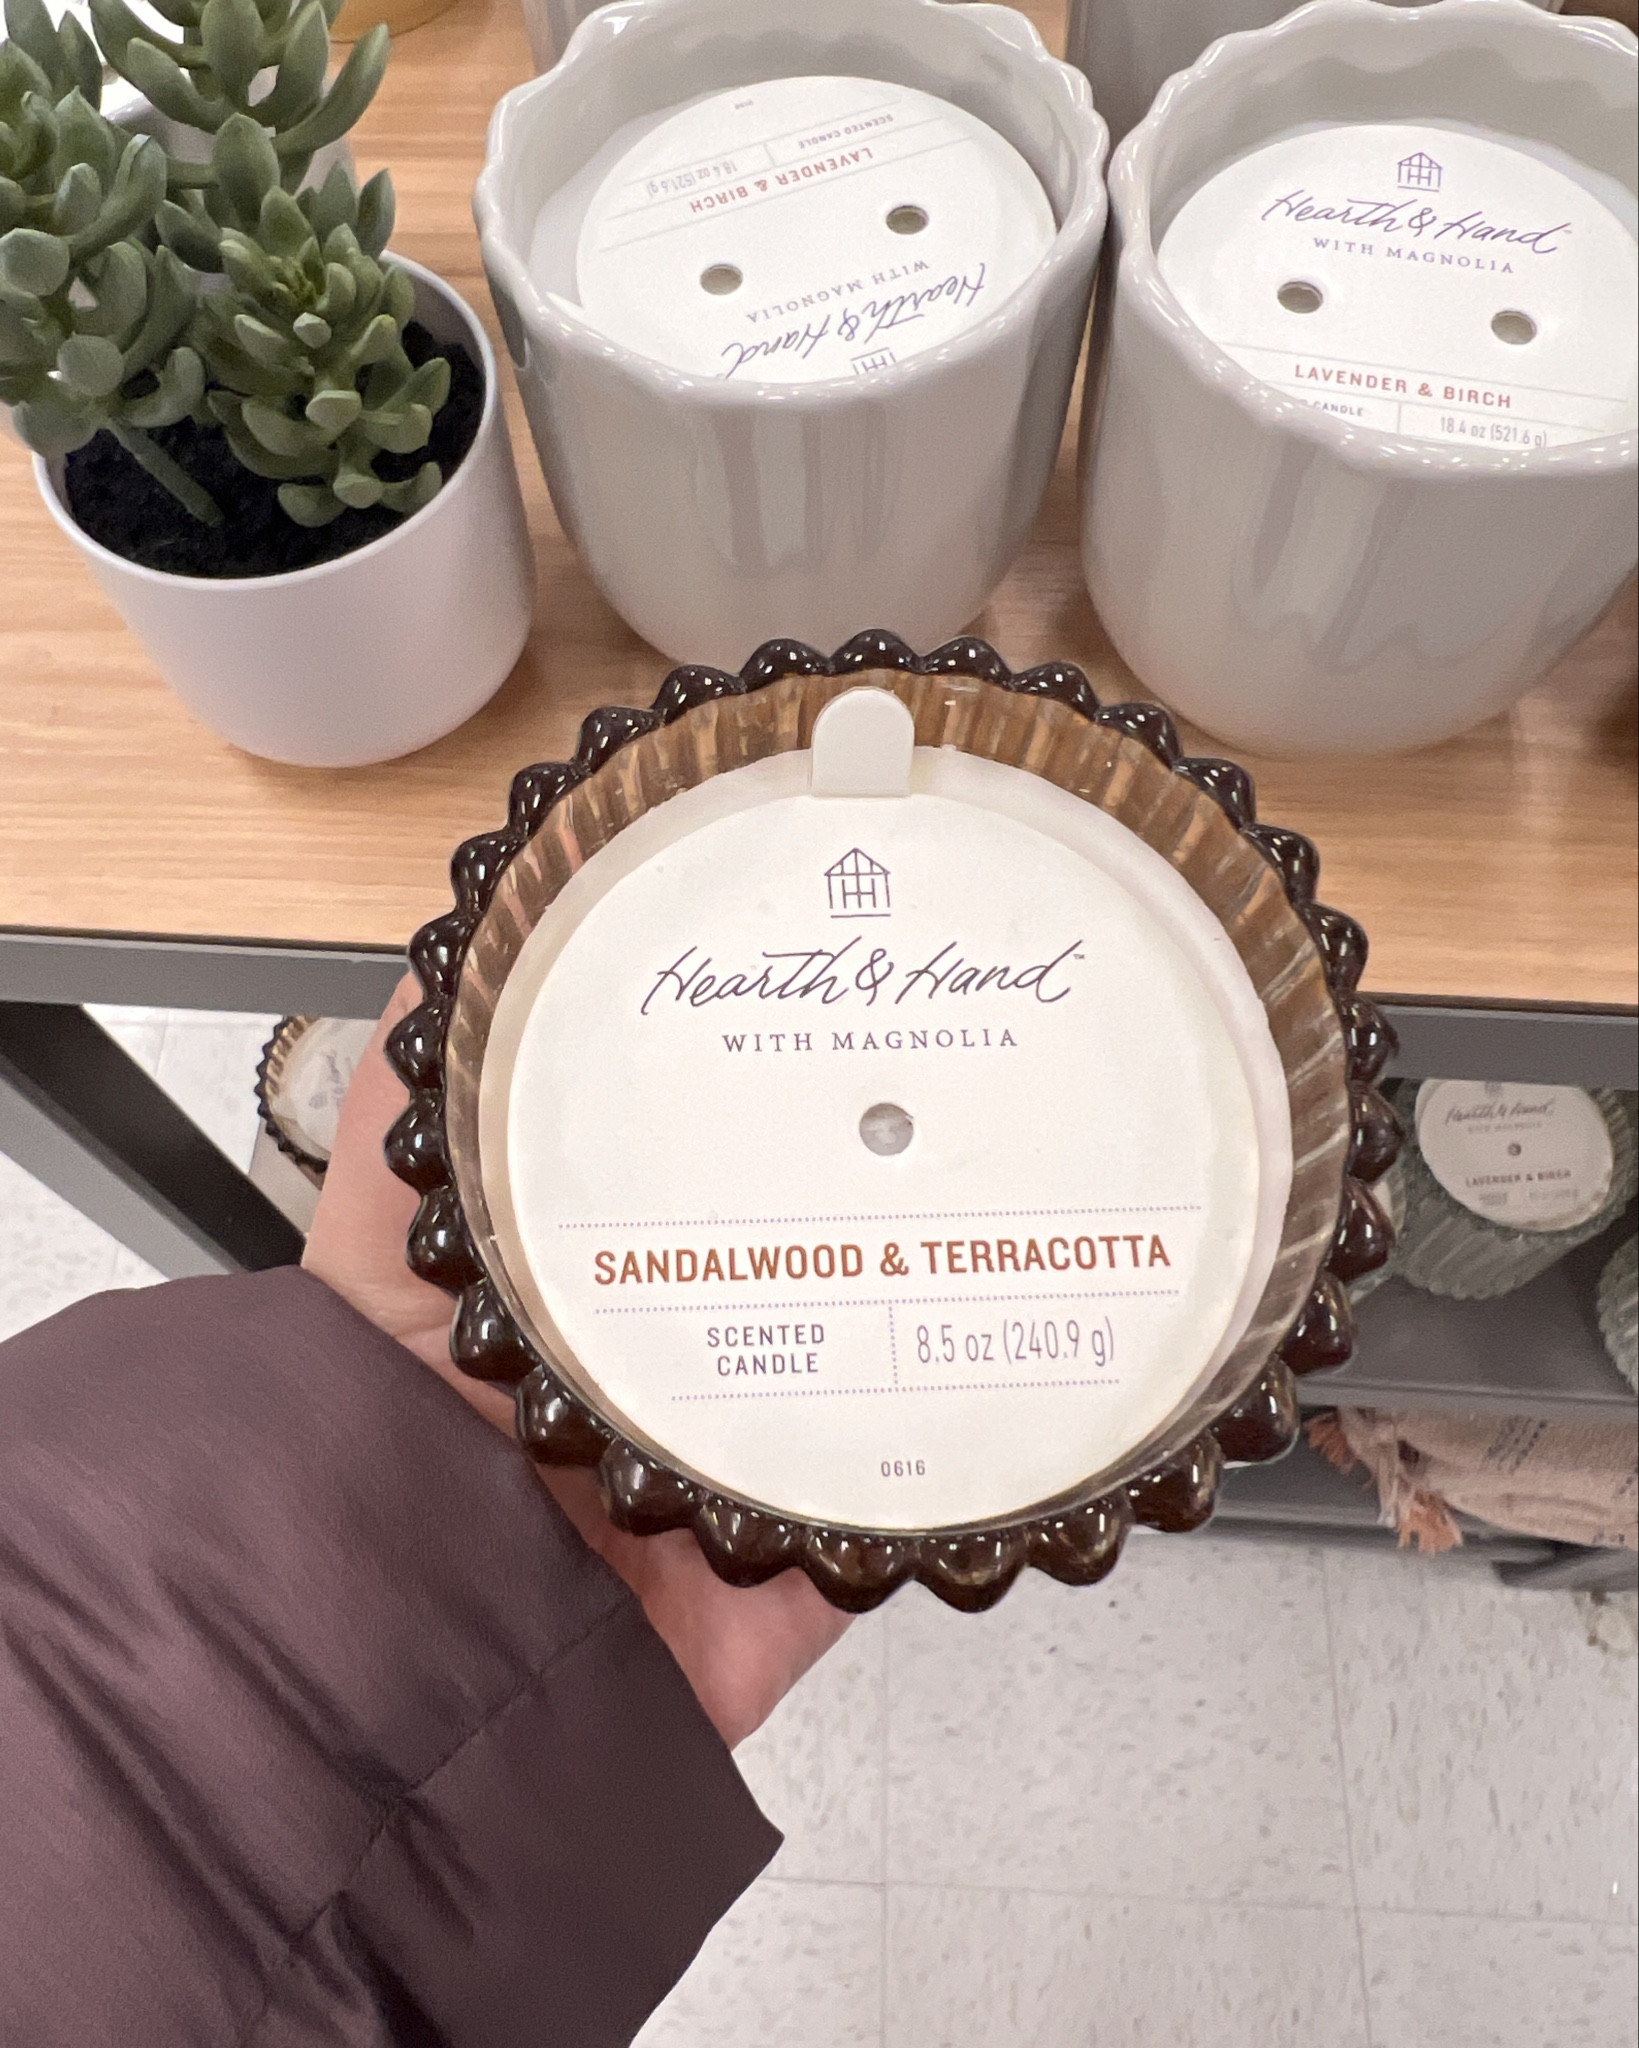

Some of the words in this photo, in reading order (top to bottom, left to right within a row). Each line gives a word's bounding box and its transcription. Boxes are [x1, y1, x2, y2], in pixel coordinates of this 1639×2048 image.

[799, 130, 841, 149] CANDLE
[844, 114, 894, 136] SCENTED
[698, 167, 711, 179] oz
[776, 147, 874, 186] LAVENDER
[690, 186, 749, 213] BIRCH
[754, 179, 769, 192] &
[1261, 190, 1418, 233] Hearth
[1408, 206, 1437, 236] &
[1313, 238, 1375, 256] WITH
[1387, 247, 1515, 274] MAGNOLIA
[871, 259, 930, 284] WITH
[747, 280, 863, 323] MAGNOLIA
[864, 262, 986, 343] Hearth
[837, 308, 860, 341] &
[721, 314, 831, 379] Hand
[1295, 364, 1408, 393] LAVENDER
[1417, 382, 1433, 397] &
[1443, 386, 1512, 409] BIRCH
[1440, 417, 1467, 434] 18.4
[1471, 425, 1486, 439] oz
[1490, 426, 1530, 445] (521.6
[641, 936, 861, 1015] Hearth
[856, 948, 895, 1006] &
[723, 1033, 813, 1053] WITH
[832, 1028, 1018, 1052] MAGNOLIA
[595, 1243, 864, 1286] SANDALWOOD
[880, 1243, 910, 1277] &
[921, 1234, 1171, 1275] TERRACOTTA
[707, 1324, 825, 1349] SCENTED
[917, 1325, 956, 1364] 8.5
[966, 1333, 995, 1363] oz
[1004, 1318, 1081, 1364] (240.9
[1092, 1316, 1115, 1368] g)
[717, 1351, 820, 1377] CANDLE
[881, 1460, 926, 1478] 0616
